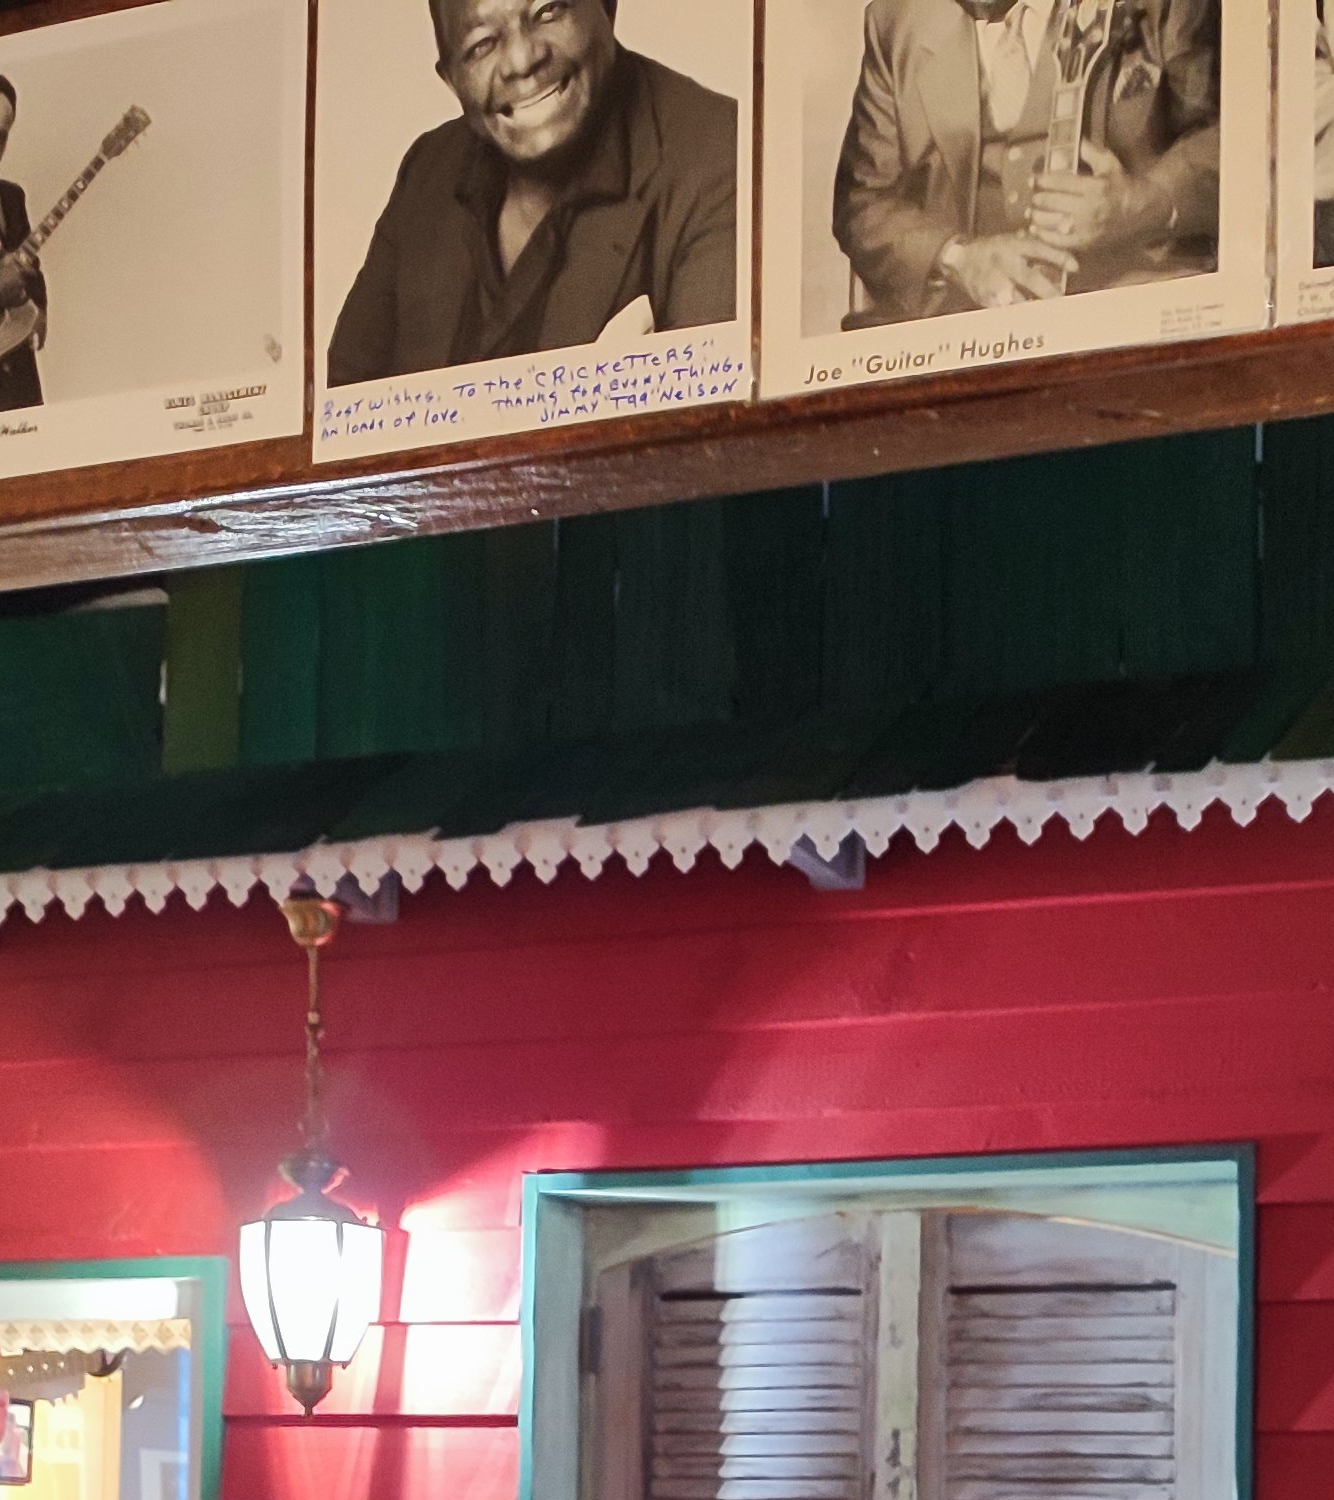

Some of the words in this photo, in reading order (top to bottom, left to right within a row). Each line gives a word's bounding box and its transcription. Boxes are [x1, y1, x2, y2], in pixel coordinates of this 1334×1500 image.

[804, 364, 843, 385] Joe
[852, 342, 951, 375] "Guitar"
[959, 333, 1045, 360] Hughes
[453, 382, 476, 397] To
[484, 376, 523, 393] the
